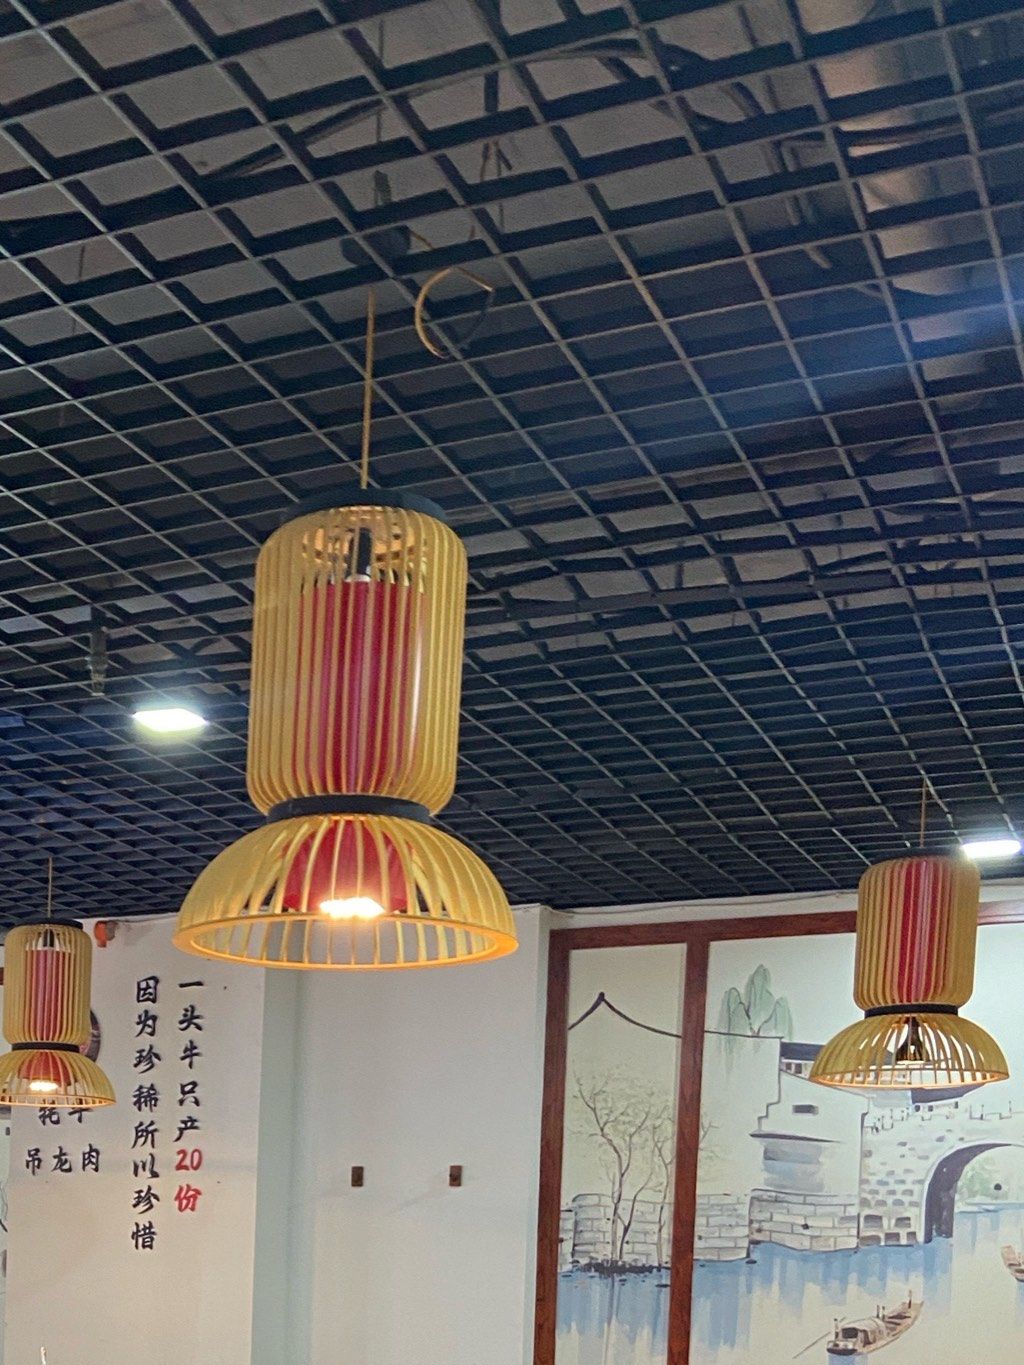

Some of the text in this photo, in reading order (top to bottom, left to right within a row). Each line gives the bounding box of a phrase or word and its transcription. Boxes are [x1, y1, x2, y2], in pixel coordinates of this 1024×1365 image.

[25, 1143, 101, 1176] 吊龙肉
[130, 975, 162, 1251] 因为珍稀所以珍惜
